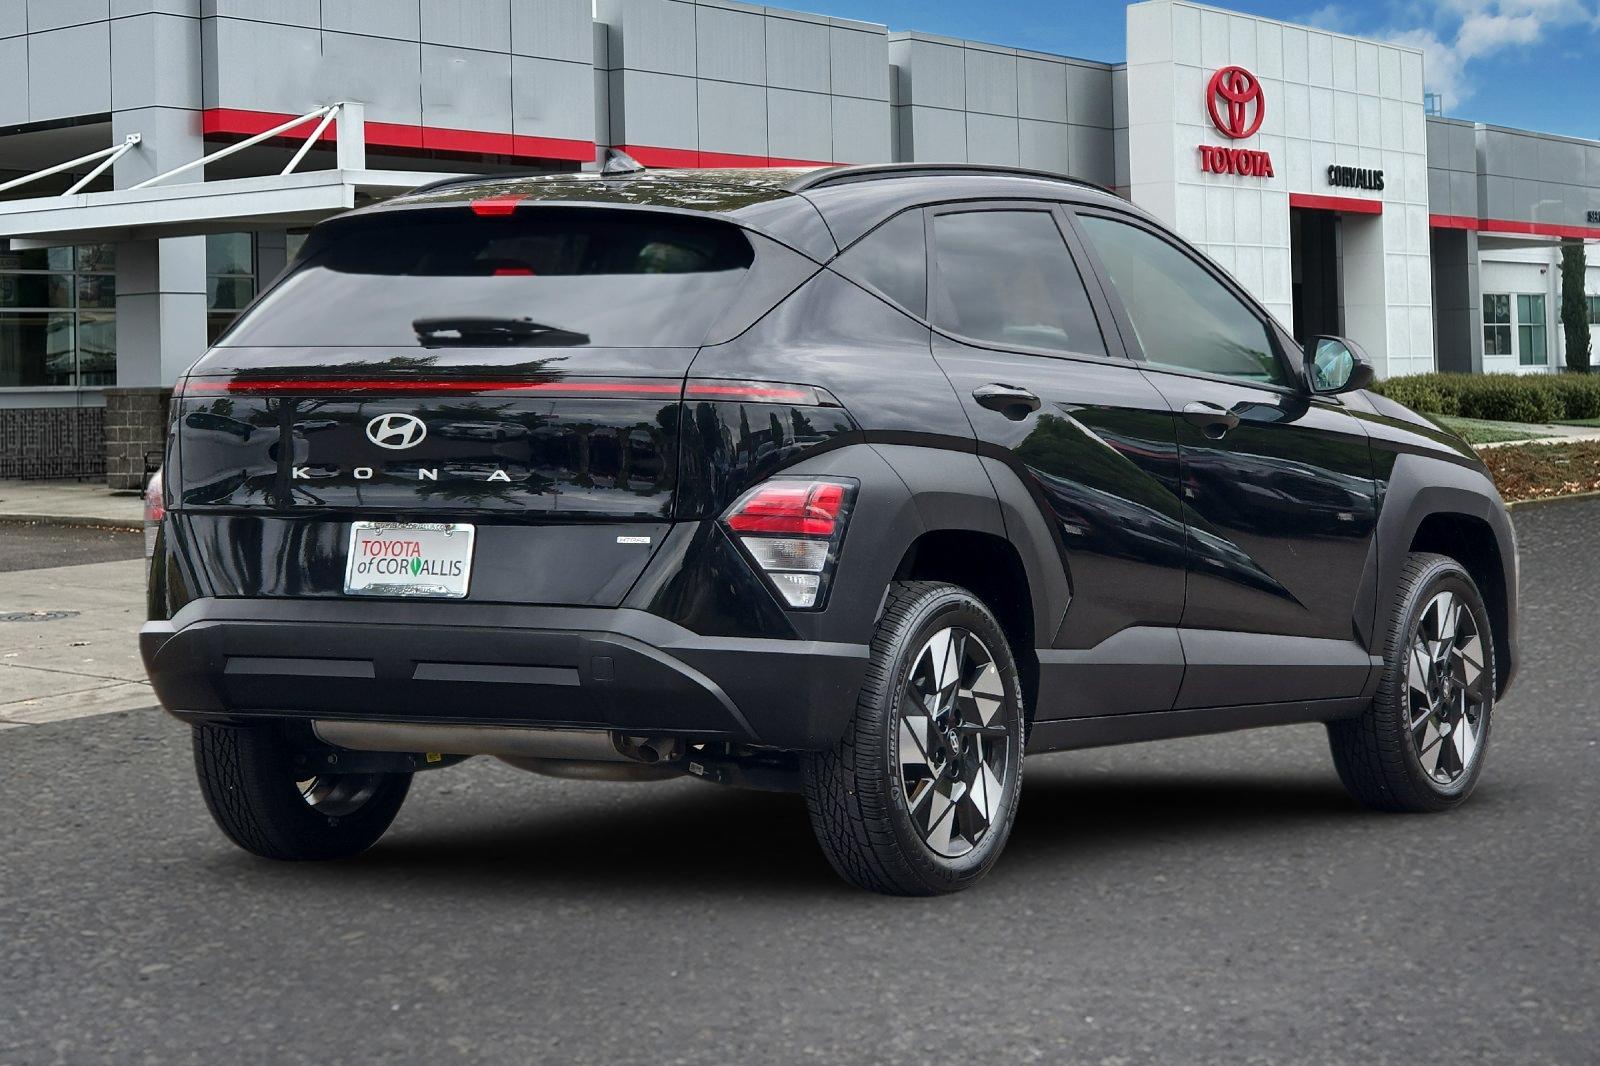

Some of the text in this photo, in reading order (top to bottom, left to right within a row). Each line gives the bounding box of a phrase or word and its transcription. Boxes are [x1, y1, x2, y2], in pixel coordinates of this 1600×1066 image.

[1198, 145, 1275, 178] TOYOTA
[1327, 164, 1385, 191] CORVALLIS
[292, 467, 511, 482] KONA
[361, 540, 421, 558] TOYOTA
[357, 557, 462, 577] of CORVALLIS
